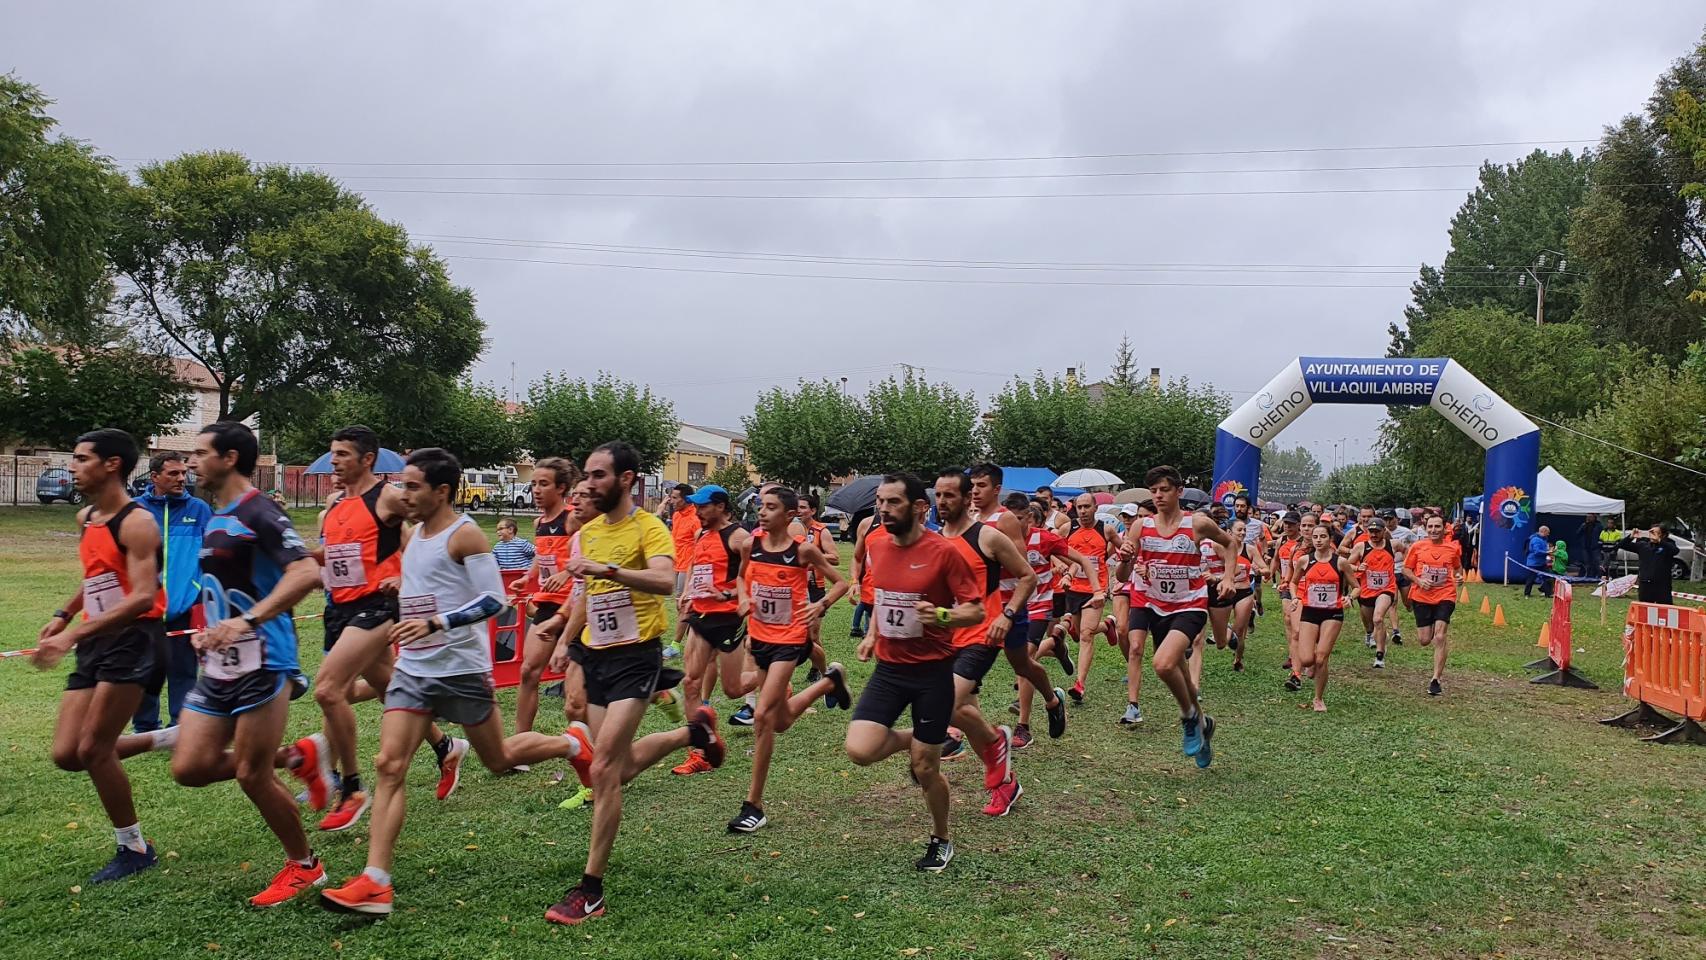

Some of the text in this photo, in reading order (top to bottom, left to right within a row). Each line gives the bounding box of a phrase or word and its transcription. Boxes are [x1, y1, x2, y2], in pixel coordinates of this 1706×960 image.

[1306, 364, 1439, 376] AYUNTAMIENTO DE
[1309, 381, 1433, 395] VILLAQUILAMBRE
[333, 560, 348, 577] 65
[1160, 580, 1176, 594] 92
[95, 595, 105, 612] 1
[1318, 592, 1327, 602] 12
[761, 600, 776, 614] 91
[598, 612, 618, 632] 55
[886, 608, 904, 627] 42
